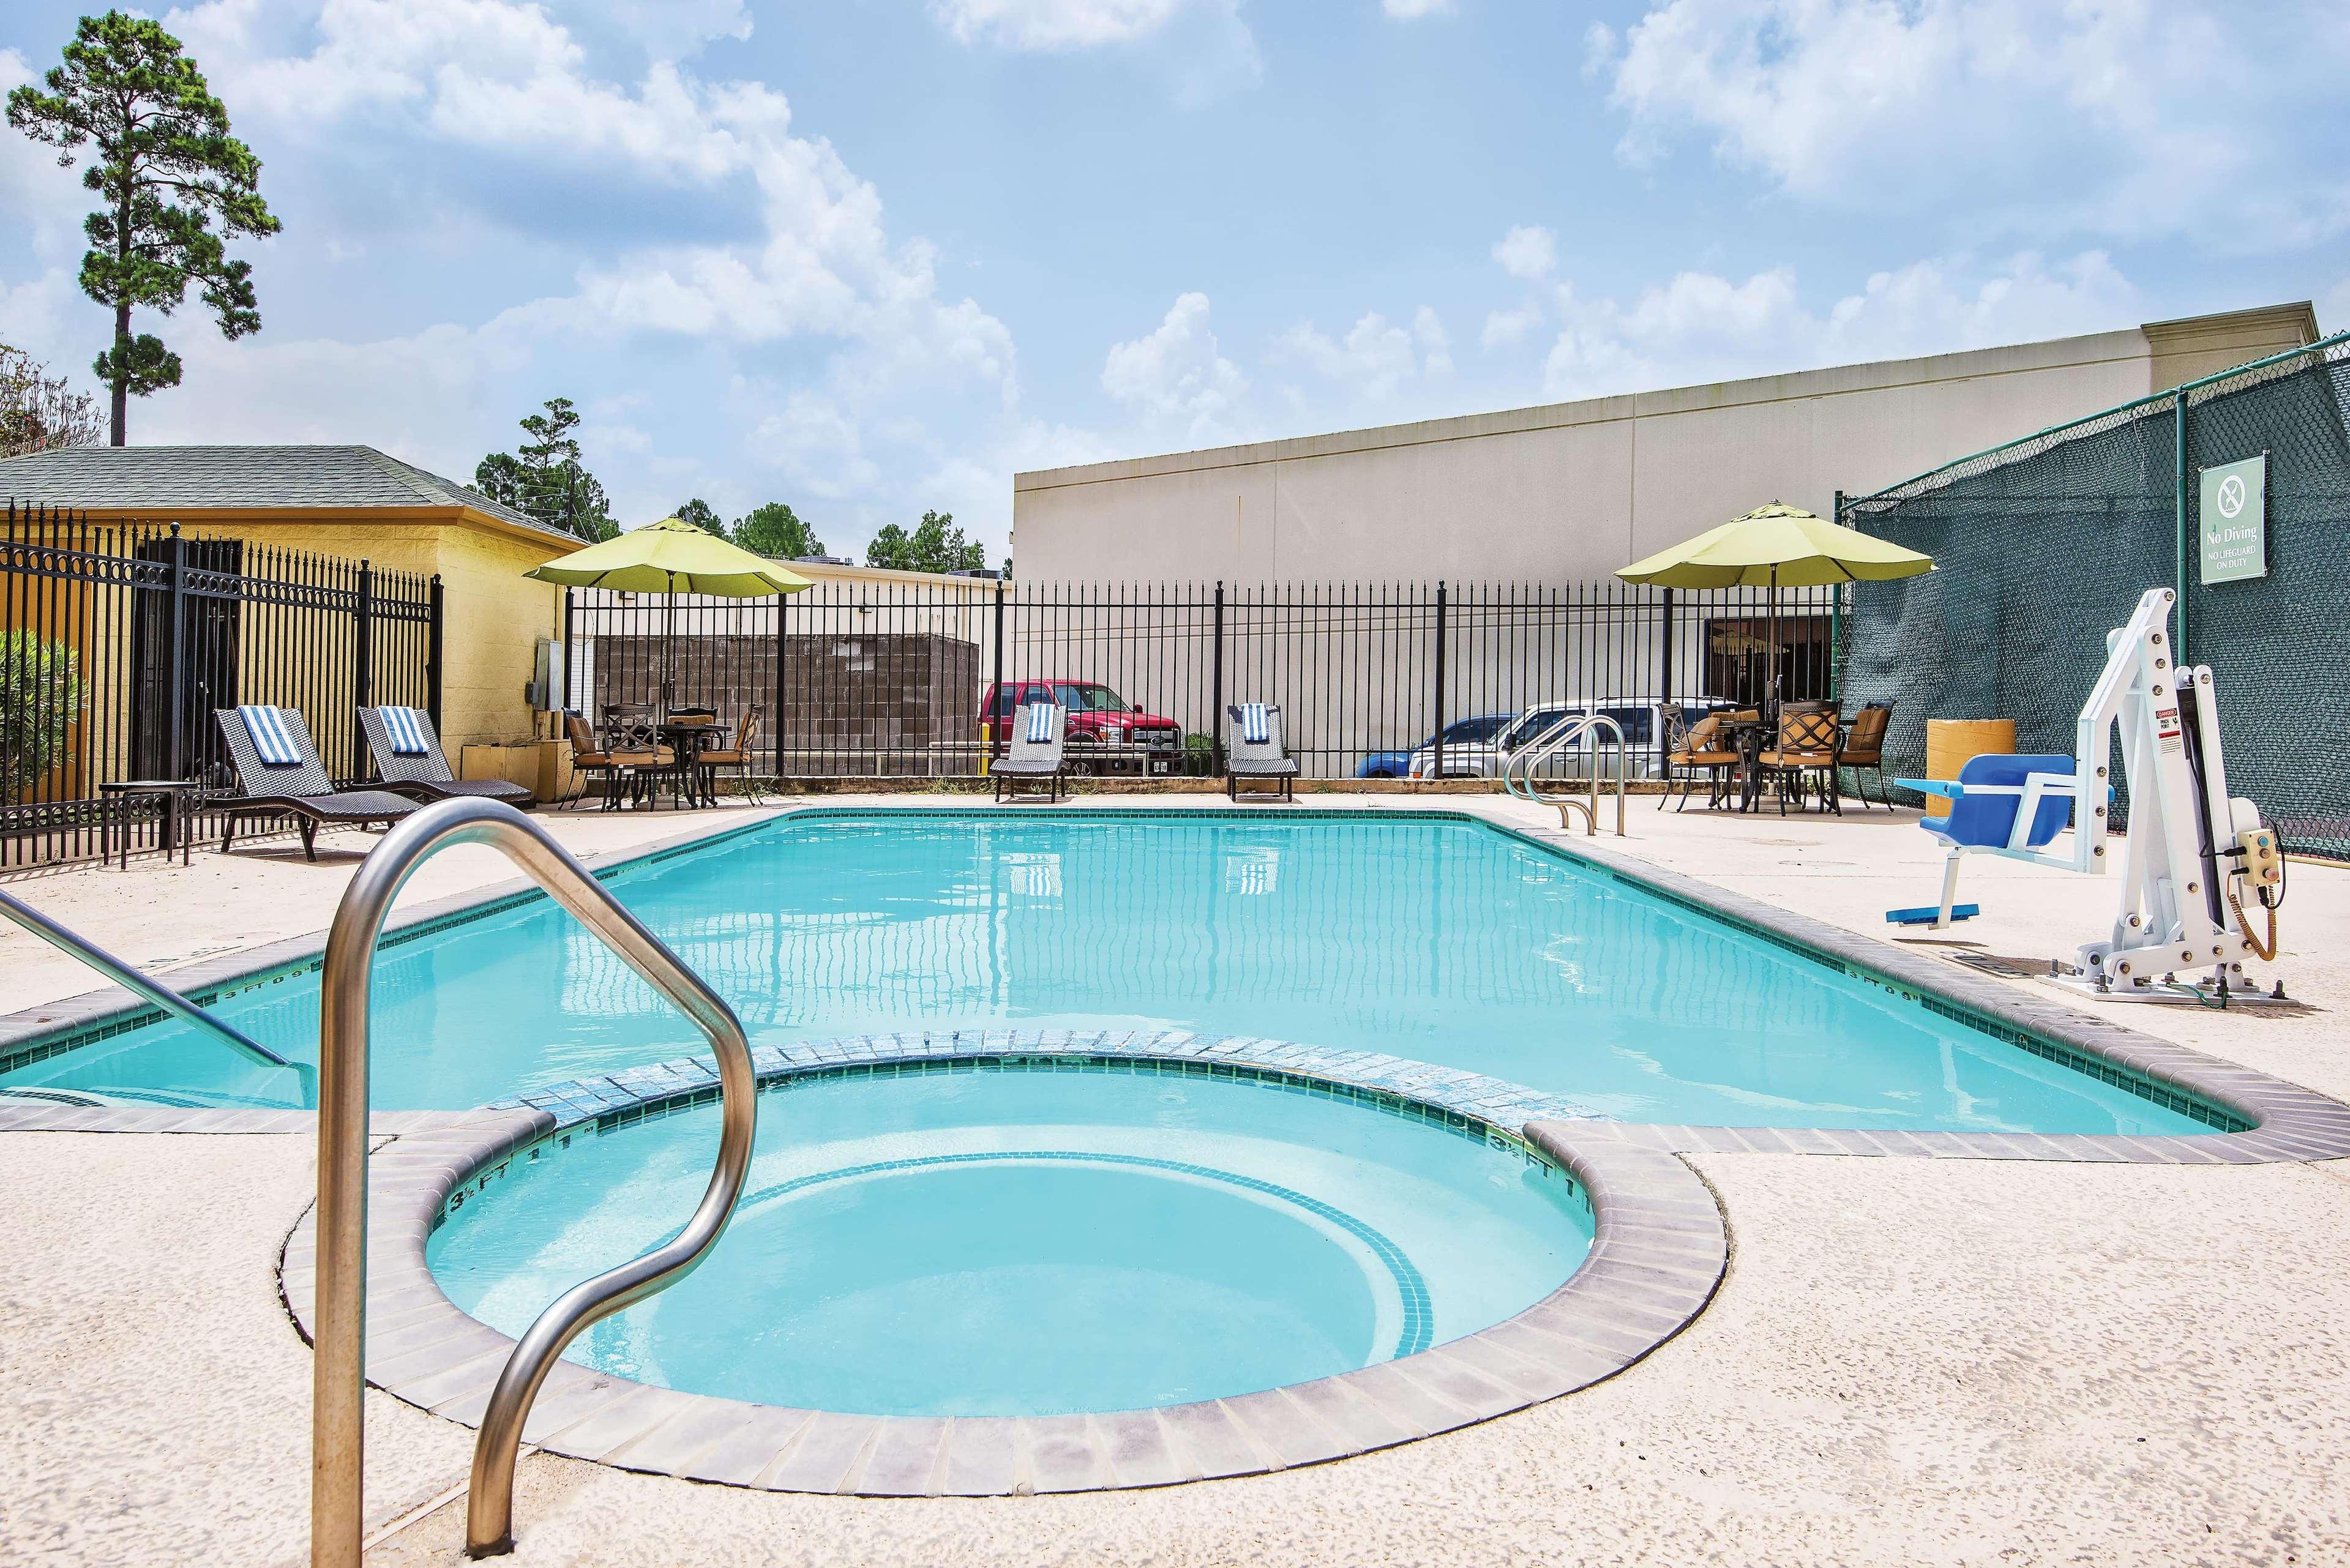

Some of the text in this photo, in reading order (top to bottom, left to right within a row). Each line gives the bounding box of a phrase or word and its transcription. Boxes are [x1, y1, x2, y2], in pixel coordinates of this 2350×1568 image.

[2207, 525, 2258, 545] No Diving
[2208, 545, 2256, 561] NO LIFEGUARD
[2217, 558, 2247, 570] ON DUTY
[1864, 976, 1879, 987] FT
[225, 991, 236, 999] 3
[245, 982, 265, 993] FT
[1526, 1151, 1553, 1178] FT
